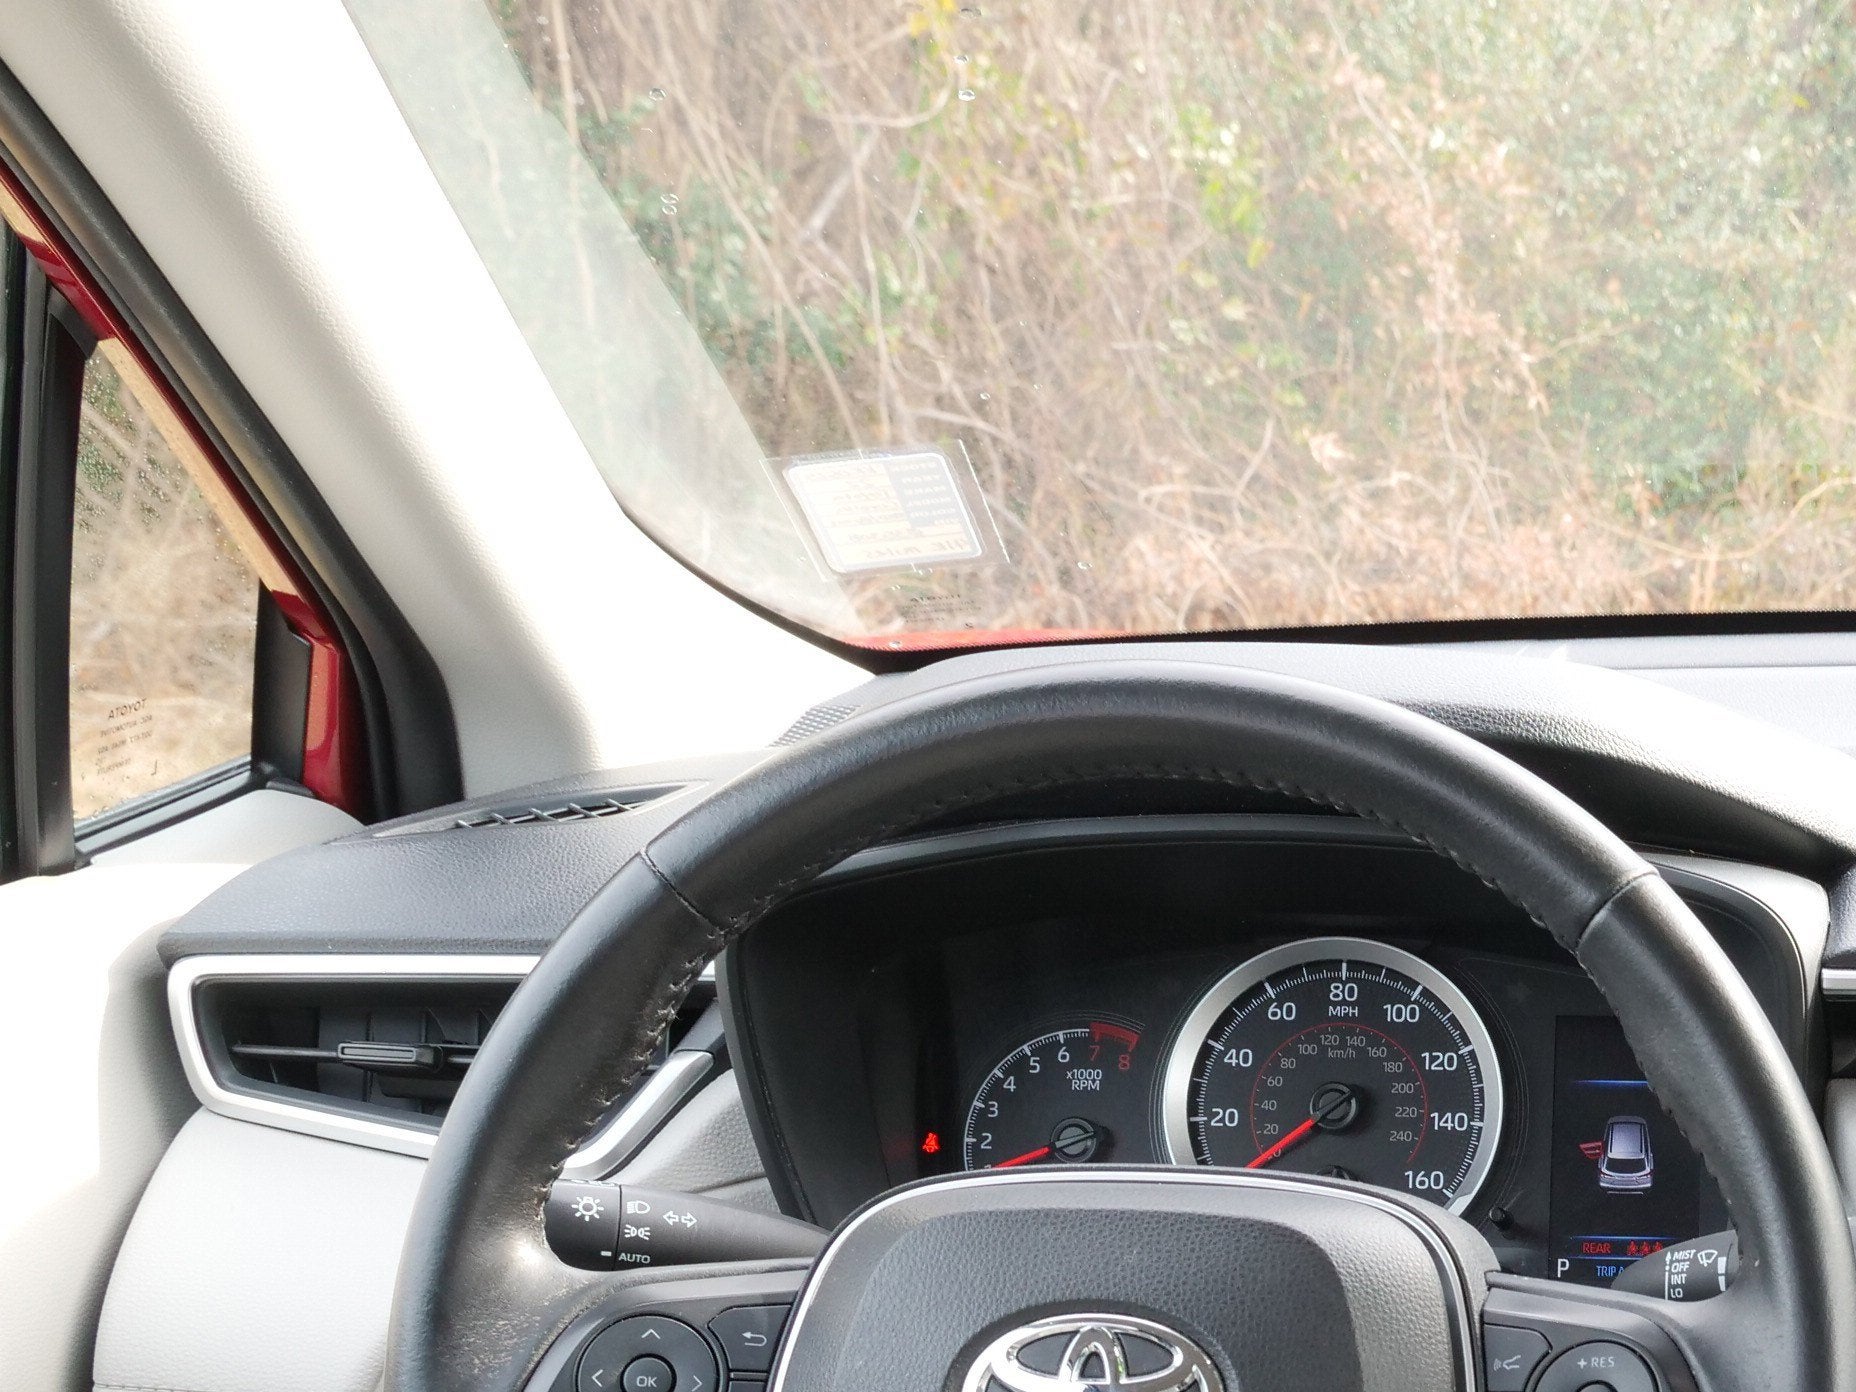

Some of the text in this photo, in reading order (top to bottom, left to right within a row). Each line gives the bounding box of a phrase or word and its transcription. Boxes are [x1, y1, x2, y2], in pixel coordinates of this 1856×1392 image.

[1329, 983, 1358, 1001] 80
[1267, 1002, 1296, 1020] 60
[1328, 1006, 1358, 1017] MPH
[1383, 1004, 1419, 1023] 100
[1320, 1035, 1339, 1046] 120
[1346, 1036, 1366, 1047] 140
[1058, 1046, 1070, 1062] 6
[1089, 1045, 1100, 1061] 7
[1299, 1045, 1317, 1055] 100
[1328, 1048, 1356, 1059] km/h
[1367, 1047, 1387, 1058] 160
[1118, 1054, 1130, 1070] 8
[1223, 1048, 1253, 1067] 40
[1280, 1058, 1296, 1069] 80
[1421, 1052, 1458, 1071] 120
[1029, 1057, 1041, 1074] 5
[1383, 1062, 1403, 1073] 180
[1066, 1069, 1102, 1080] x1000
[1003, 1076, 1016, 1092] 4
[1072, 1080, 1100, 1091] RPM
[1267, 1076, 1283, 1087] 60
[1391, 1083, 1414, 1094] 200
[988, 1102, 999, 1117] 3
[1261, 1100, 1277, 1110] 40
[1210, 1108, 1239, 1127] 20
[1395, 1107, 1417, 1118] 220
[1430, 1112, 1468, 1131] 140
[1264, 1124, 1279, 1135] 20
[980, 1133, 992, 1149] 2
[1389, 1131, 1412, 1142] 240
[1404, 1171, 1444, 1190] 160
[1583, 1243, 1612, 1254] REAR
[618, 1253, 651, 1265] AUTO
[1673, 1249, 1696, 1261] MIST
[1557, 1259, 1570, 1278] P
[1596, 1266, 1617, 1277] TRIP
[1672, 1262, 1690, 1272] OFF
[1671, 1274, 1687, 1285] INT
[1671, 1287, 1684, 1299] LO
[1591, 1356, 1615, 1368] RES
[636, 1376, 657, 1388] OK
